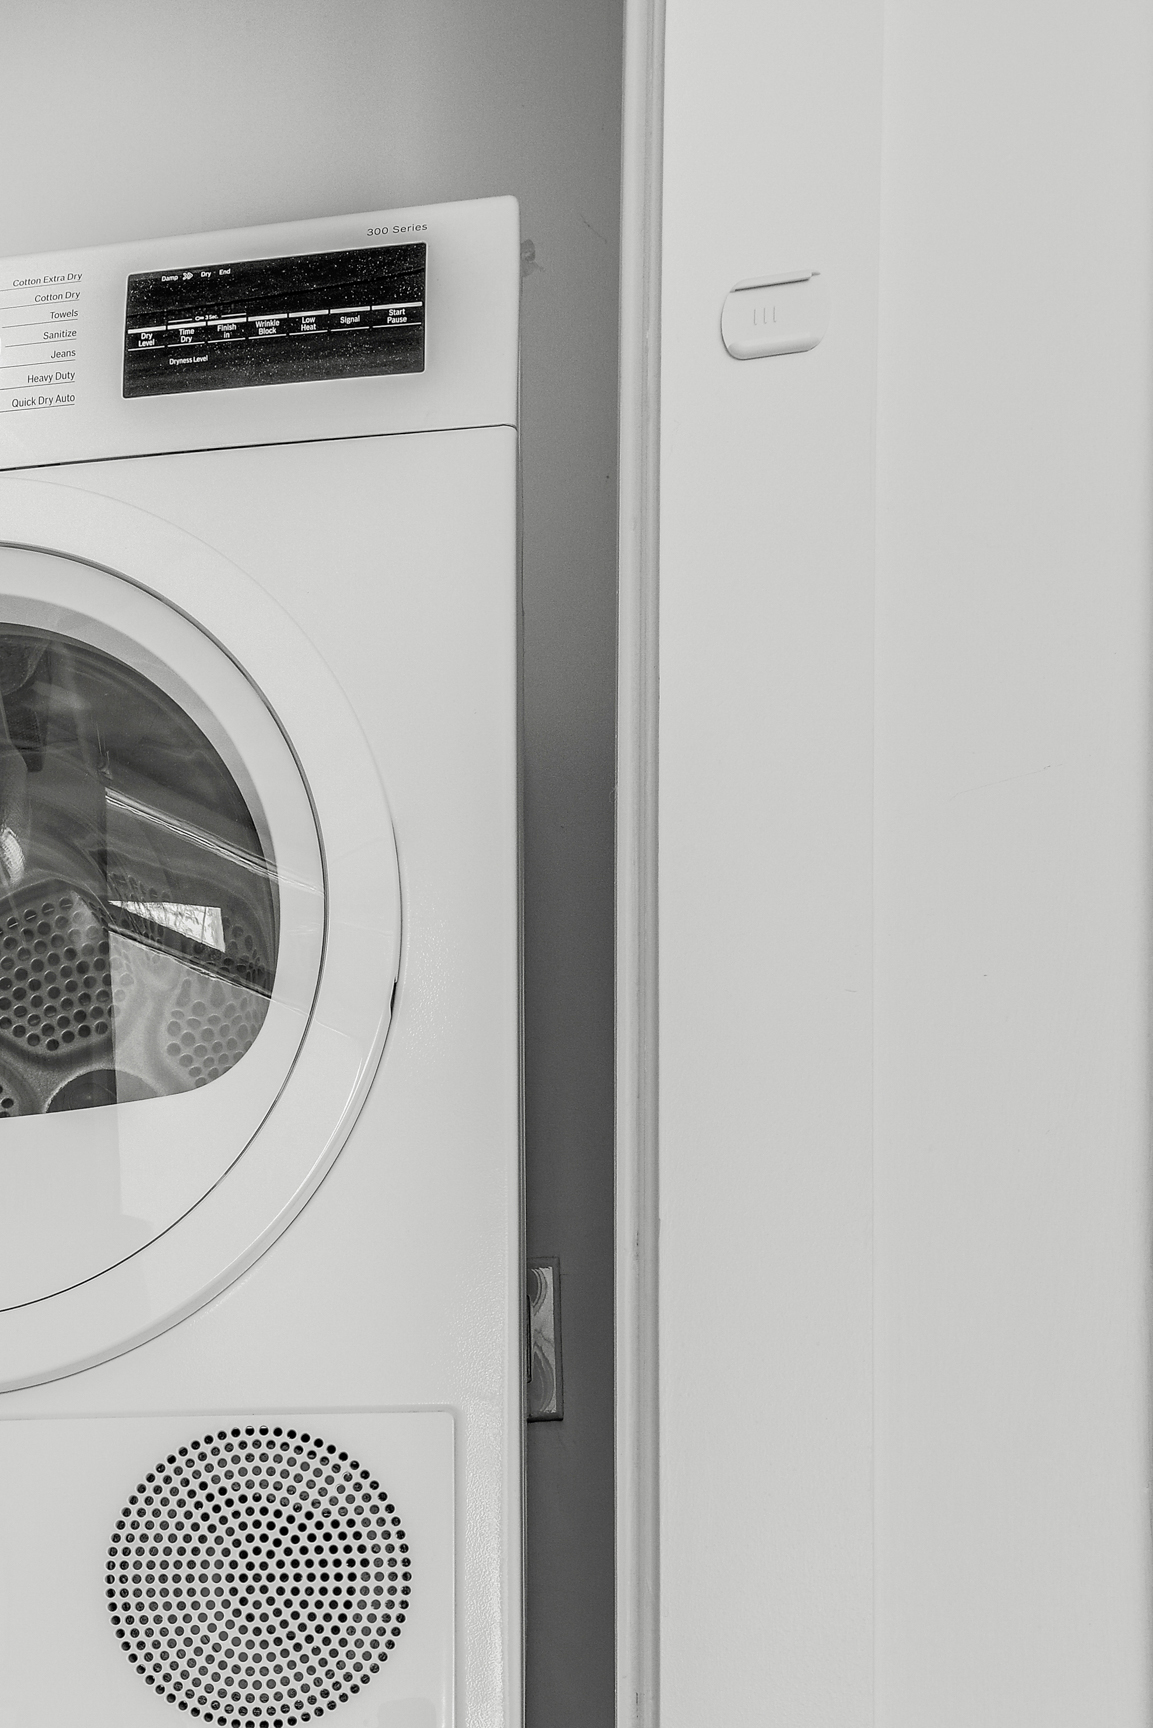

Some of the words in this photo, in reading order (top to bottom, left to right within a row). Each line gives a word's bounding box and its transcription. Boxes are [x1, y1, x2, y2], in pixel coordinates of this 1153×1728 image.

[367, 226, 388, 236] 300
[393, 223, 428, 234] Series
[12, 278, 41, 286] Cotton
[44, 274, 65, 283] Extra
[67, 272, 82, 280] Dry
[34, 293, 63, 302] Cotton
[66, 291, 80, 299] Dry
[50, 309, 78, 319] Towels
[256, 319, 280, 328] Wrinkle
[340, 315, 360, 324] Signal
[387, 316, 408, 324] Pause
[258, 326, 276, 334] Block
[300, 324, 316, 332] Heat
[43, 330, 77, 340] Sanitize
[138, 339, 154, 347] Level
[51, 349, 76, 358] Jeans
[170, 356, 192, 365] Dryness
[28, 374, 53, 384] Heavy
[55, 371, 76, 380] Duty
[12, 397, 36, 408] Quick
[38, 396, 53, 406] Dry
[56, 394, 76, 403] Auto
